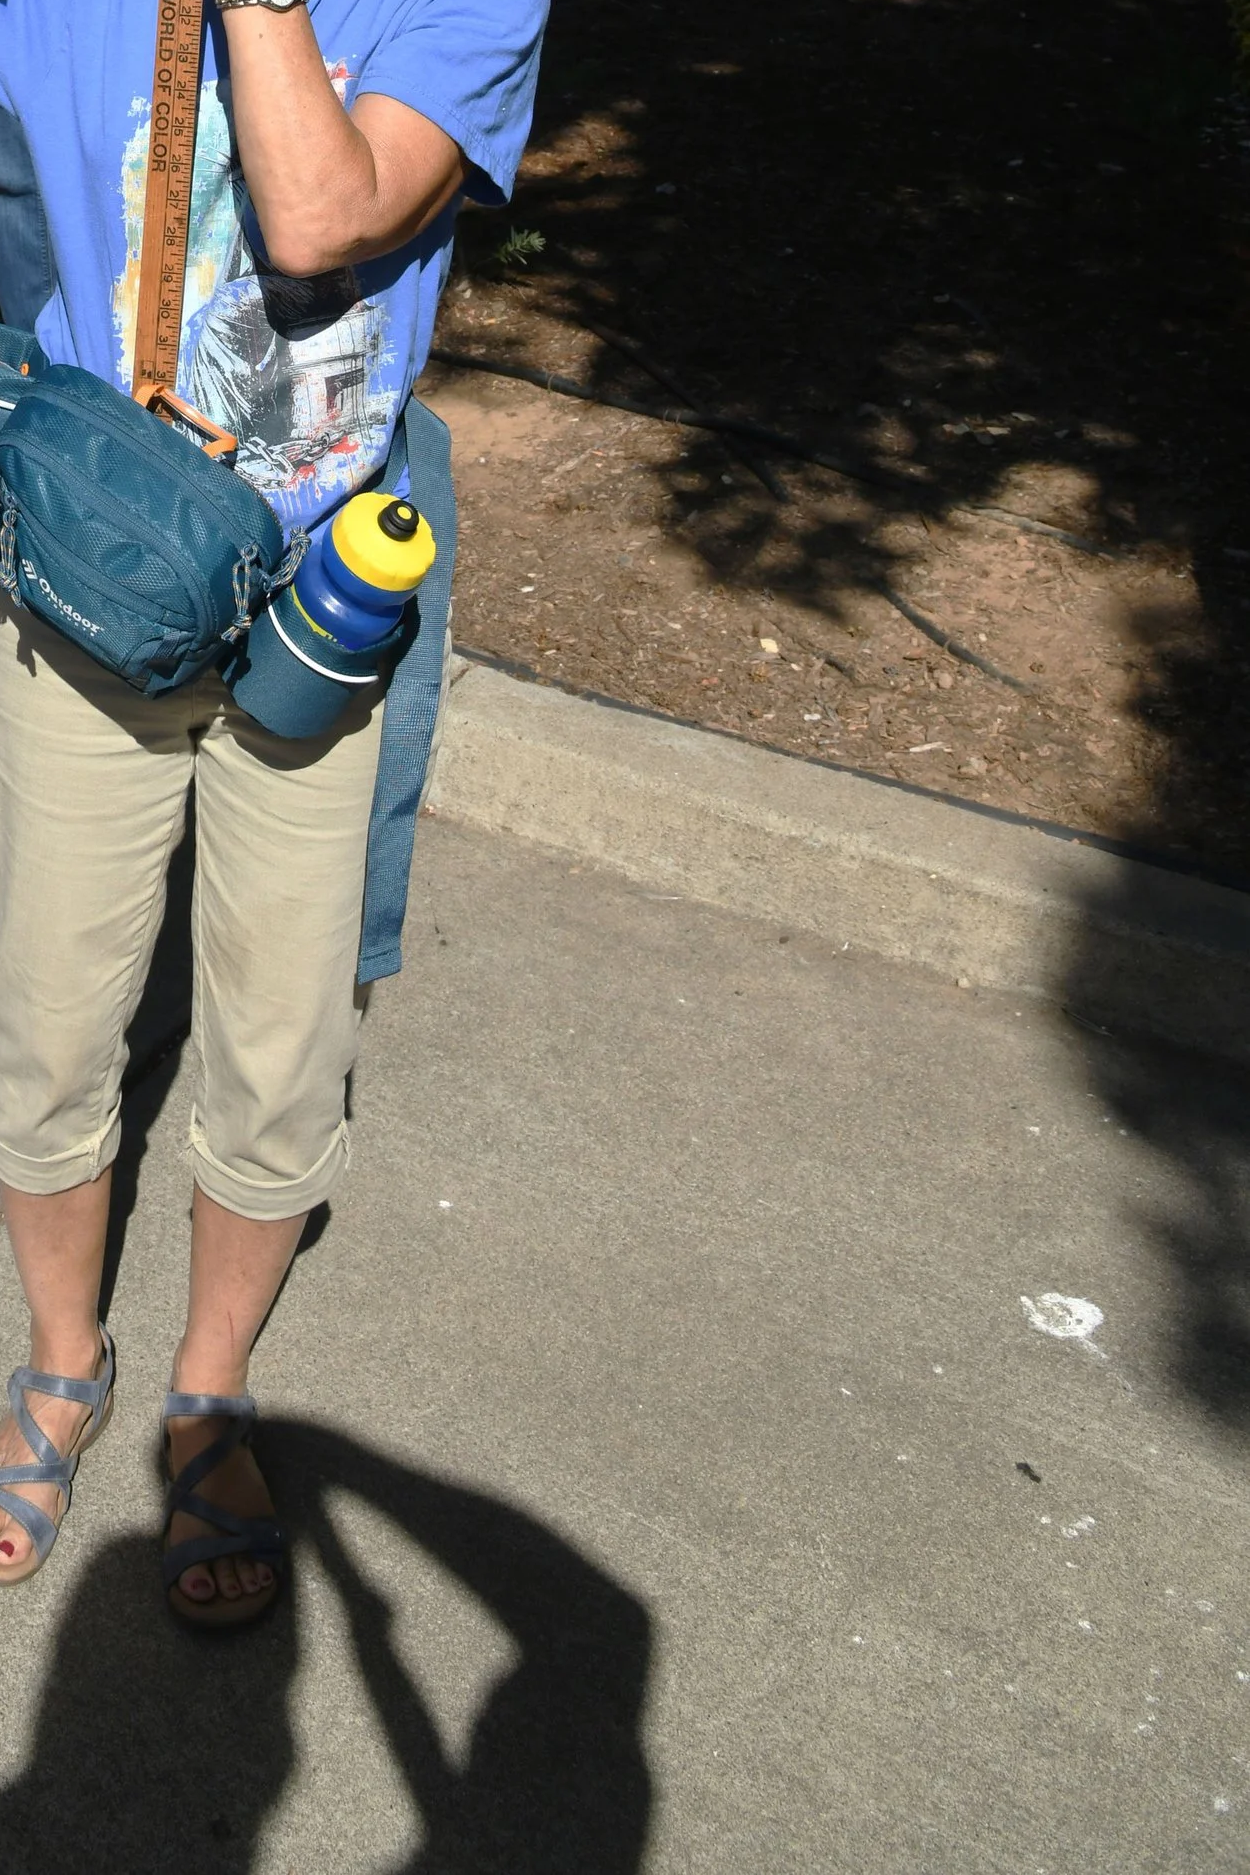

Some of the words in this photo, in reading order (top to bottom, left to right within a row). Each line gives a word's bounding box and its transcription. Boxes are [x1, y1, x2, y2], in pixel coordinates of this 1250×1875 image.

[157, 69, 172, 96] OF
[152, 102, 170, 173] COLOR
[39, 578, 100, 633] Outdoor
